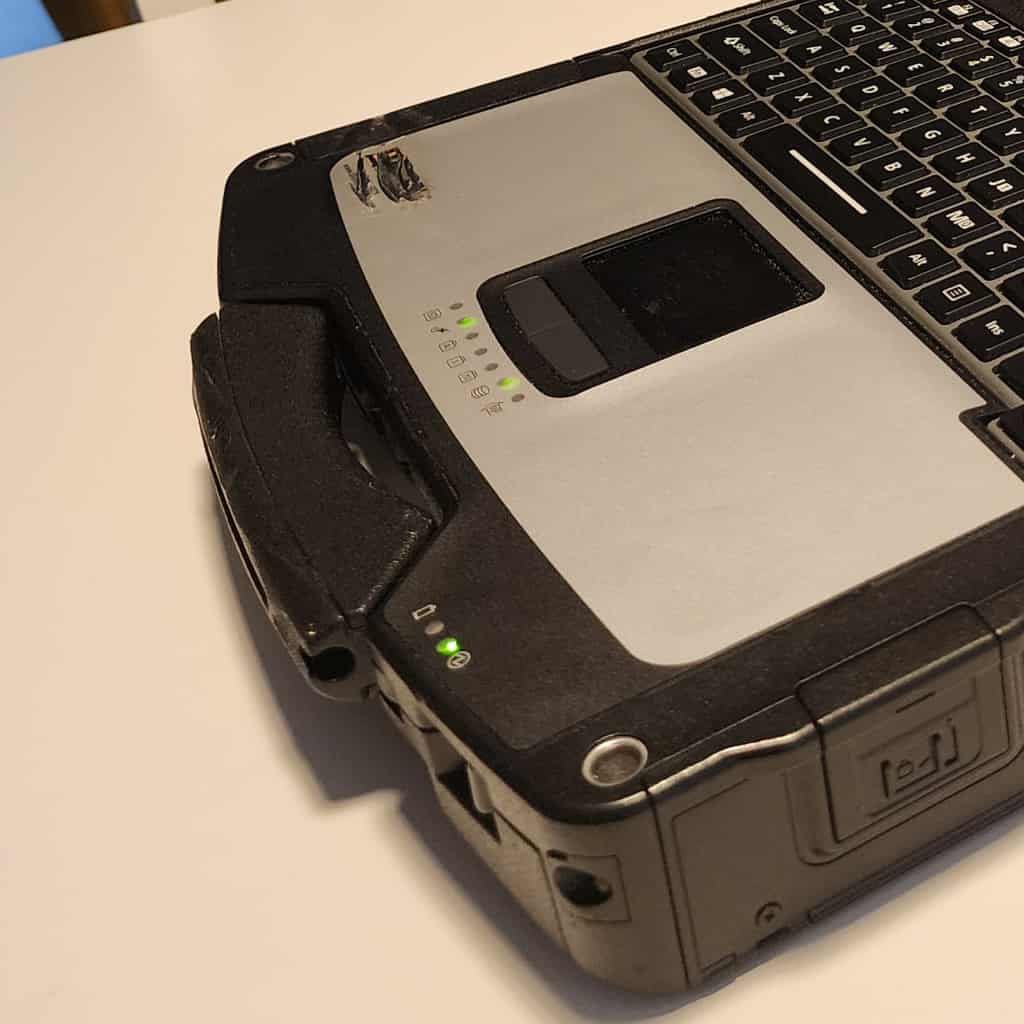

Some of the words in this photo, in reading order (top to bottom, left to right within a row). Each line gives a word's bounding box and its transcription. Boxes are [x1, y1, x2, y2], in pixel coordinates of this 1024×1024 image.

[806, 45, 822, 54] A
[878, 42, 898, 52] W
[834, 65, 850, 74] S
[907, 63, 924, 71] E
[768, 72, 785, 80] Z
[862, 85, 879, 94] D
[937, 84, 954, 92] R
[795, 93, 813, 102] X
[892, 107, 910, 116] F
[970, 105, 988, 114] T
[823, 115, 841, 124] C
[924, 130, 942, 140] G
[1004, 128, 1022, 136] Y
[853, 138, 871, 147] V
[955, 152, 976, 164] H
[883, 161, 902, 171] B
[916, 187, 936, 198] N
[908, 254, 927, 266] Alt
[985, 320, 1005, 336] Ins
